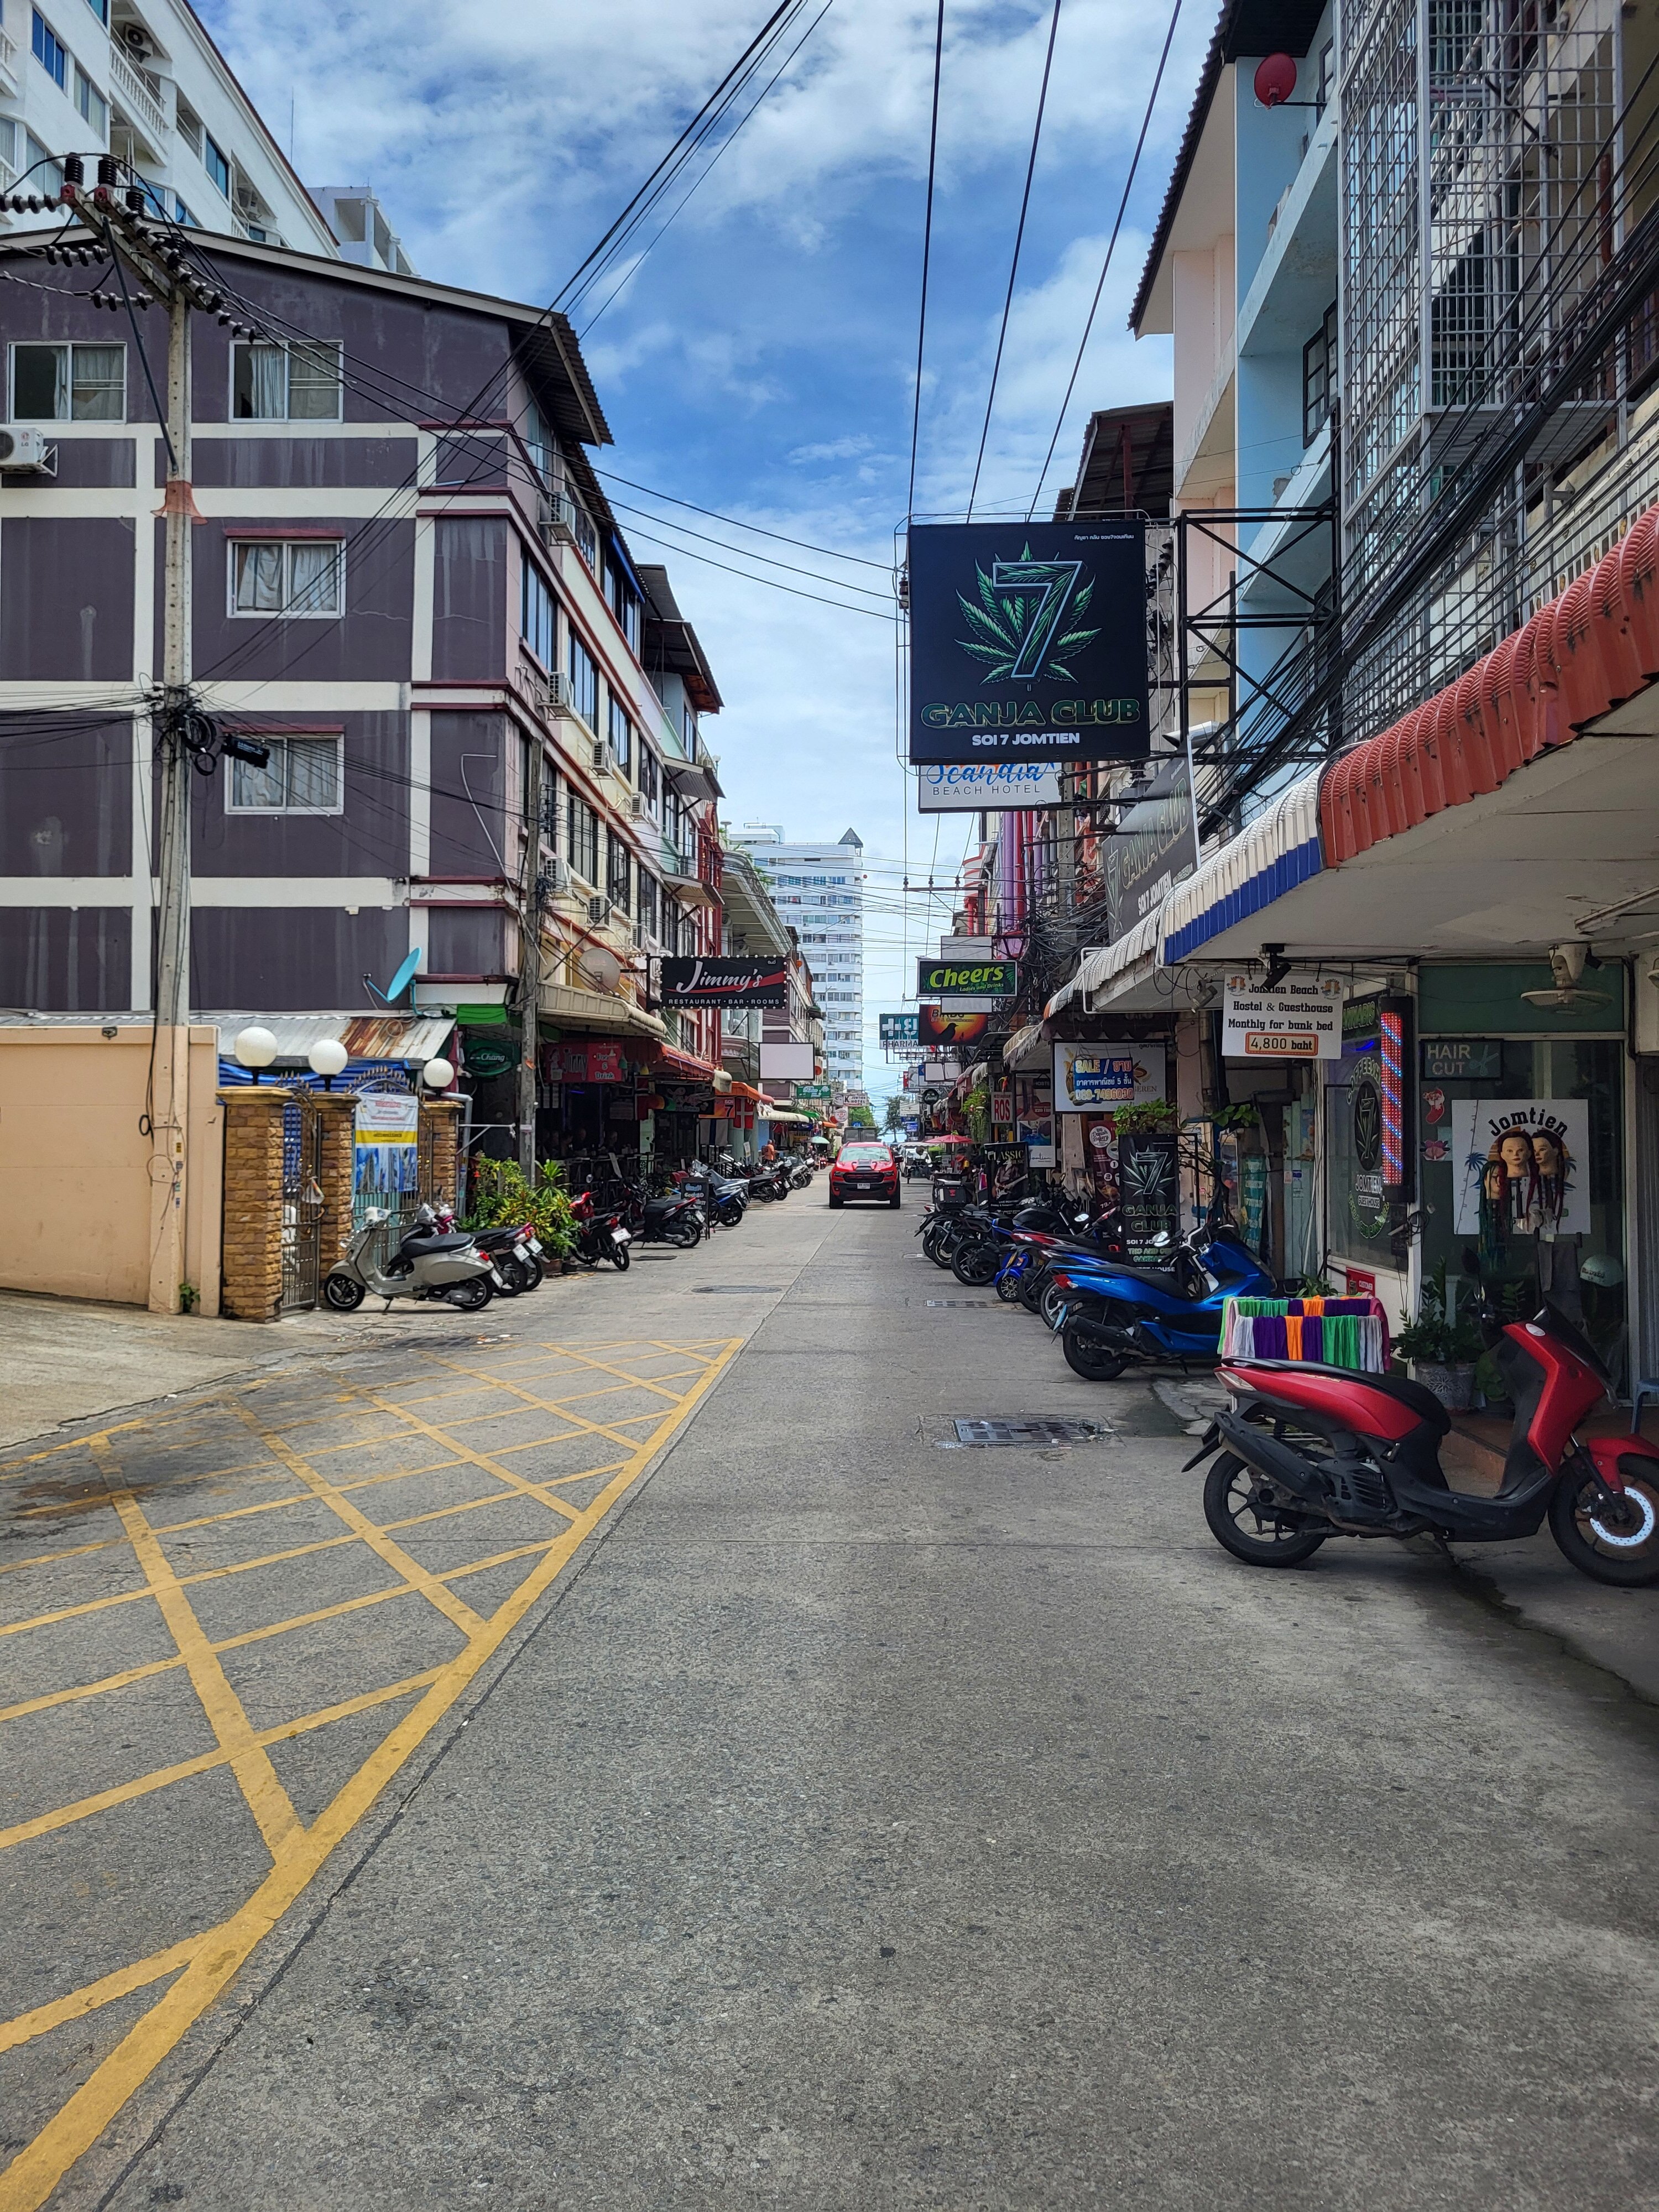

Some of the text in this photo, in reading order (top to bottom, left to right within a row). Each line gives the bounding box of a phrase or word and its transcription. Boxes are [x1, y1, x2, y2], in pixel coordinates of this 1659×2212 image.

[921, 698, 1140, 728] GANJA CLUB
[972, 732, 1080, 746] SOI 7 JOMTIEN
[933, 785, 1040, 795] BEACH HOTEL
[1120, 817, 1159, 890] GANJA
[1157, 777, 1189, 855] CLUB
[1138, 893, 1146, 916] SOI
[1150, 869, 1173, 907] JOMTIEN
[676, 961, 763, 993] Jimmy's
[930, 966, 1004, 988] Cheers
[1290, 984, 1318, 994] Beach
[1233, 1001, 1333, 1013] Hostel & Guesthouse
[1343, 1001, 1375, 1031] ANNABIS
[1228, 1019, 1333, 1031] Monthly for bunk bed
[1251, 1037, 1312, 1050] 4,800 baht
[481, 1053, 505, 1062] Chang
[1427, 1044, 1471, 1060] HAIR
[1075, 1059, 1100, 1073] SALE
[1113, 1061, 1132, 1072] ขาย
[1432, 1062, 1465, 1076] CUT
[594, 1071, 615, 1080] Drink
[1076, 1076, 1114, 1086] อาคารพาณิชย์
[1347, 1057, 1381, 1105] COFFEESH
[724, 1105, 734, 1118] 7
[994, 1099, 1010, 1121] ROS
[1488, 1107, 1568, 1139] Jomtien
[1355, 1175, 1382, 1194] JOMTIEN
[1121, 1204, 1178, 1217] GANJA
[1131, 1220, 1171, 1233] CLUB
